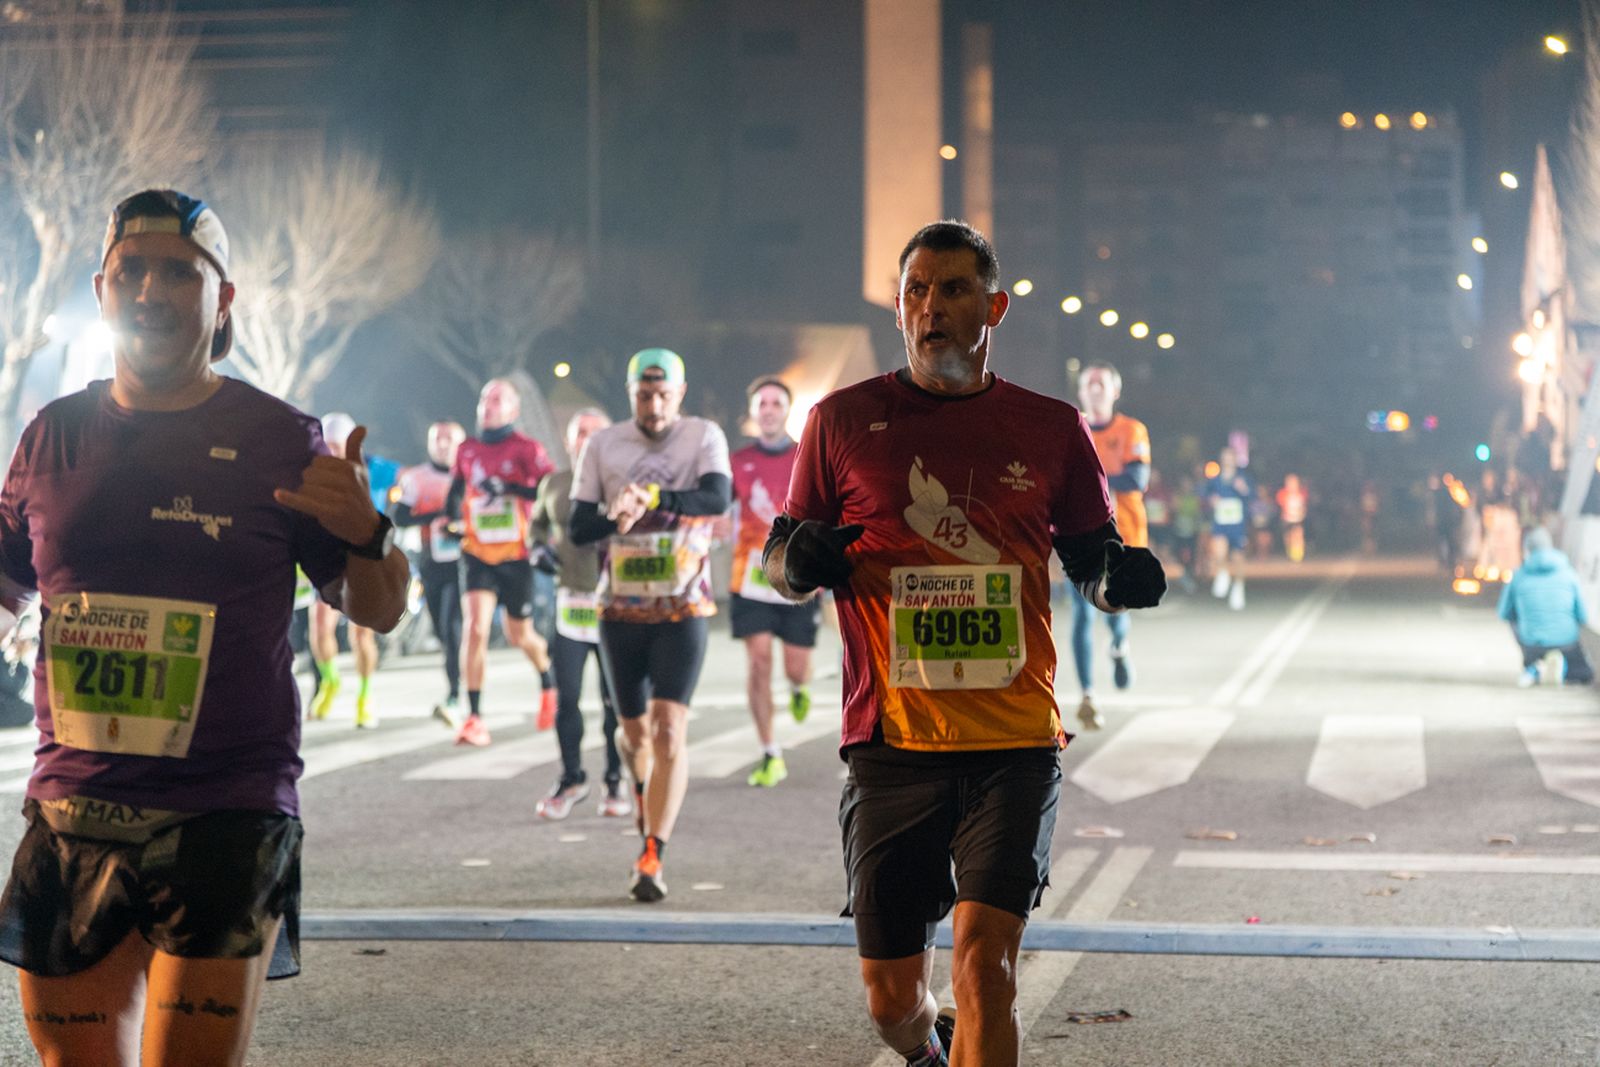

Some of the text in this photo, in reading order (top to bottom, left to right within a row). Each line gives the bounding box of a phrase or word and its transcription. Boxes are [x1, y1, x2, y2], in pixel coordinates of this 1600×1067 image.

[933, 516, 968, 548] 43
[920, 578, 975, 592] NOCHE DE
[904, 594, 929, 608] SAN
[932, 592, 976, 608] ANTÓN
[79, 610, 149, 630] NOCHE DE
[913, 609, 1002, 647] 6963
[59, 628, 89, 646] SAN
[91, 630, 148, 649] ANTÓN
[74, 650, 169, 701] 2611
